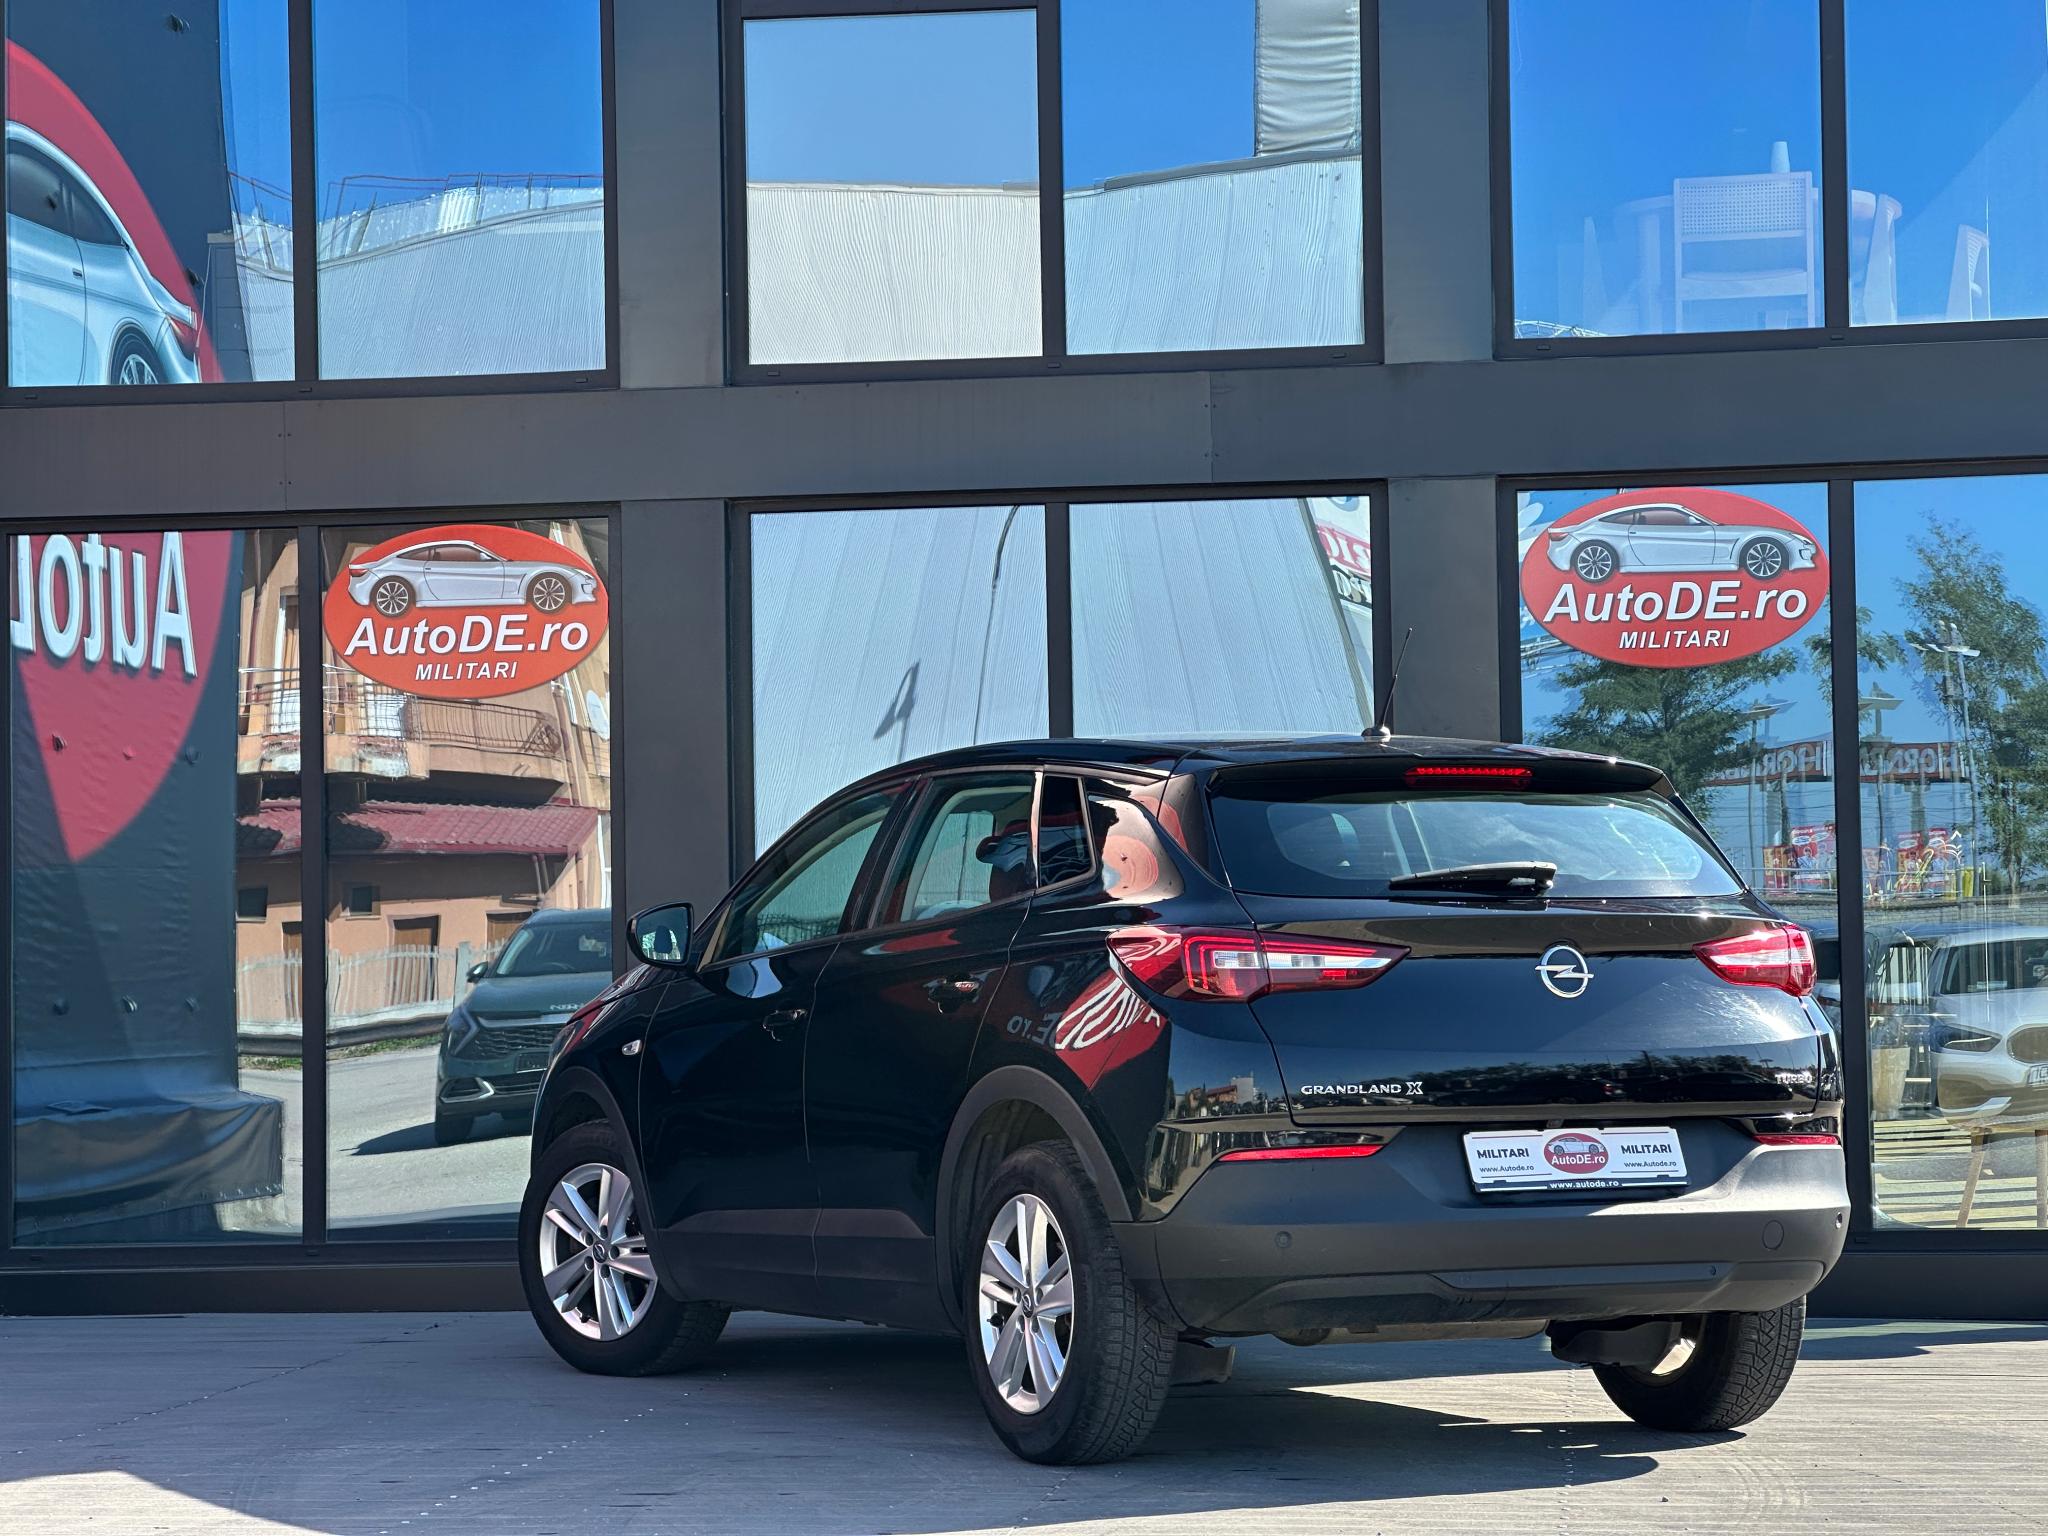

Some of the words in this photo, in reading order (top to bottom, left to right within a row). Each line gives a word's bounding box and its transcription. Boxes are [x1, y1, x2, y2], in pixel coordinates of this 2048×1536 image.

[1543, 580, 1808, 623] AutoDE.ro
[344, 614, 590, 656] AutoDE.ro
[1619, 629, 1730, 649] MILITARI
[415, 661, 518, 681] MILITARI
[1775, 1072, 1812, 1085] TURBO
[1300, 1084, 1402, 1095] GRANDLAND
[1405, 1081, 1424, 1095] X
[1476, 1147, 1530, 1159] MILITARI
[1620, 1144, 1672, 1155] MILITARI
[1551, 1153, 1606, 1166] AutoDE.ro
[1623, 1160, 1677, 1169] www.Autode.ro
[1479, 1164, 1535, 1173] www.Autode.ro
[1550, 1179, 1620, 1189] www.autode.ro
